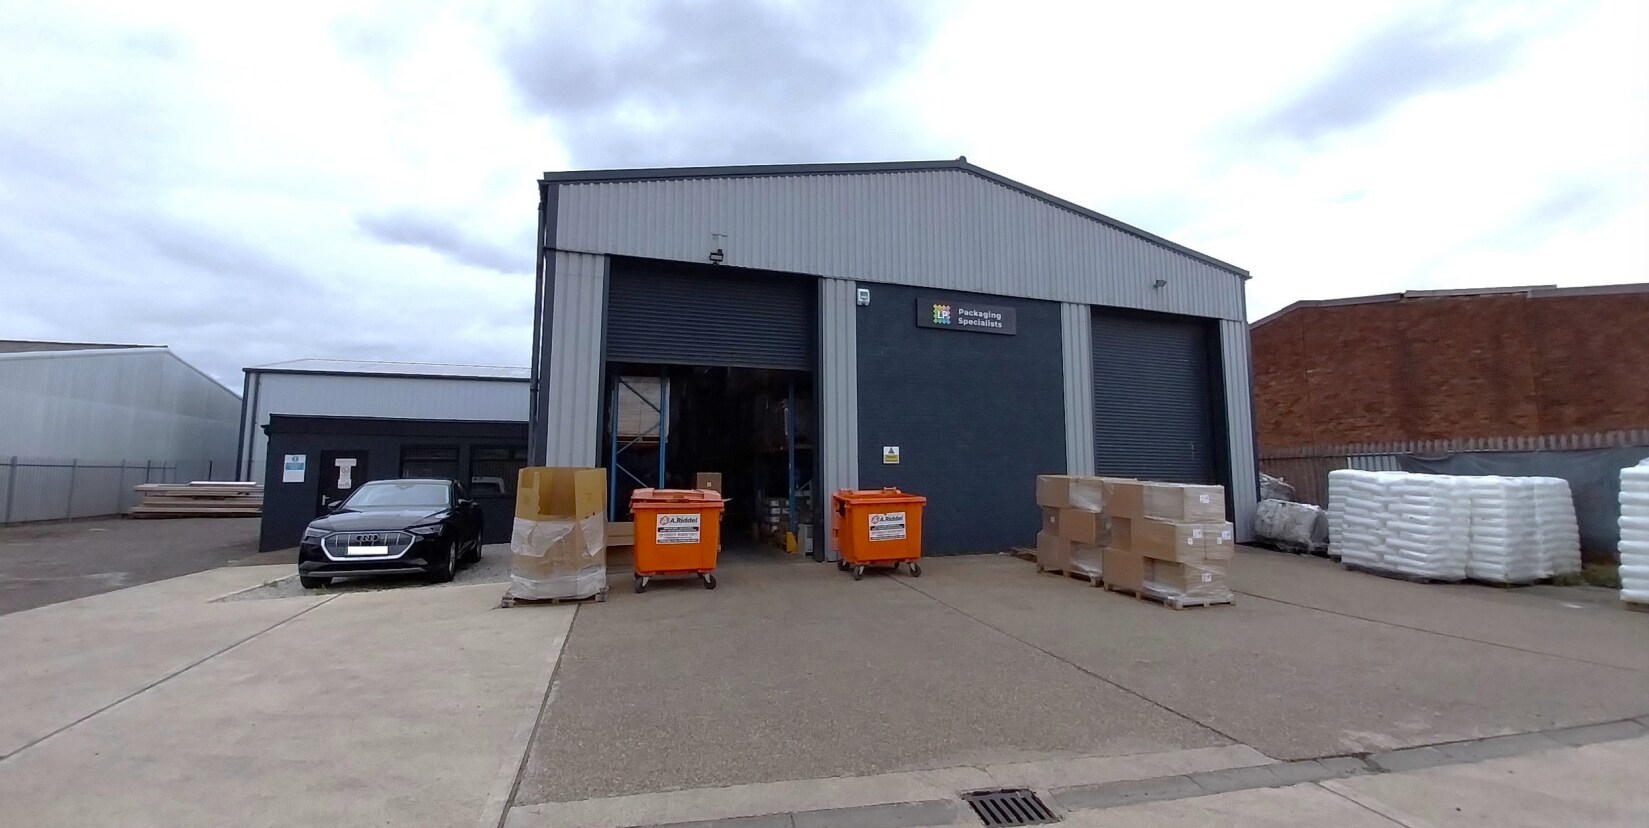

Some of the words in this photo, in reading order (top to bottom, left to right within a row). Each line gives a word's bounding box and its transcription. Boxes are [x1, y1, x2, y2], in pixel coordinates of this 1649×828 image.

[937, 310, 949, 319] LP
[958, 308, 1002, 321] Packaging
[957, 317, 1003, 328] Specialists
